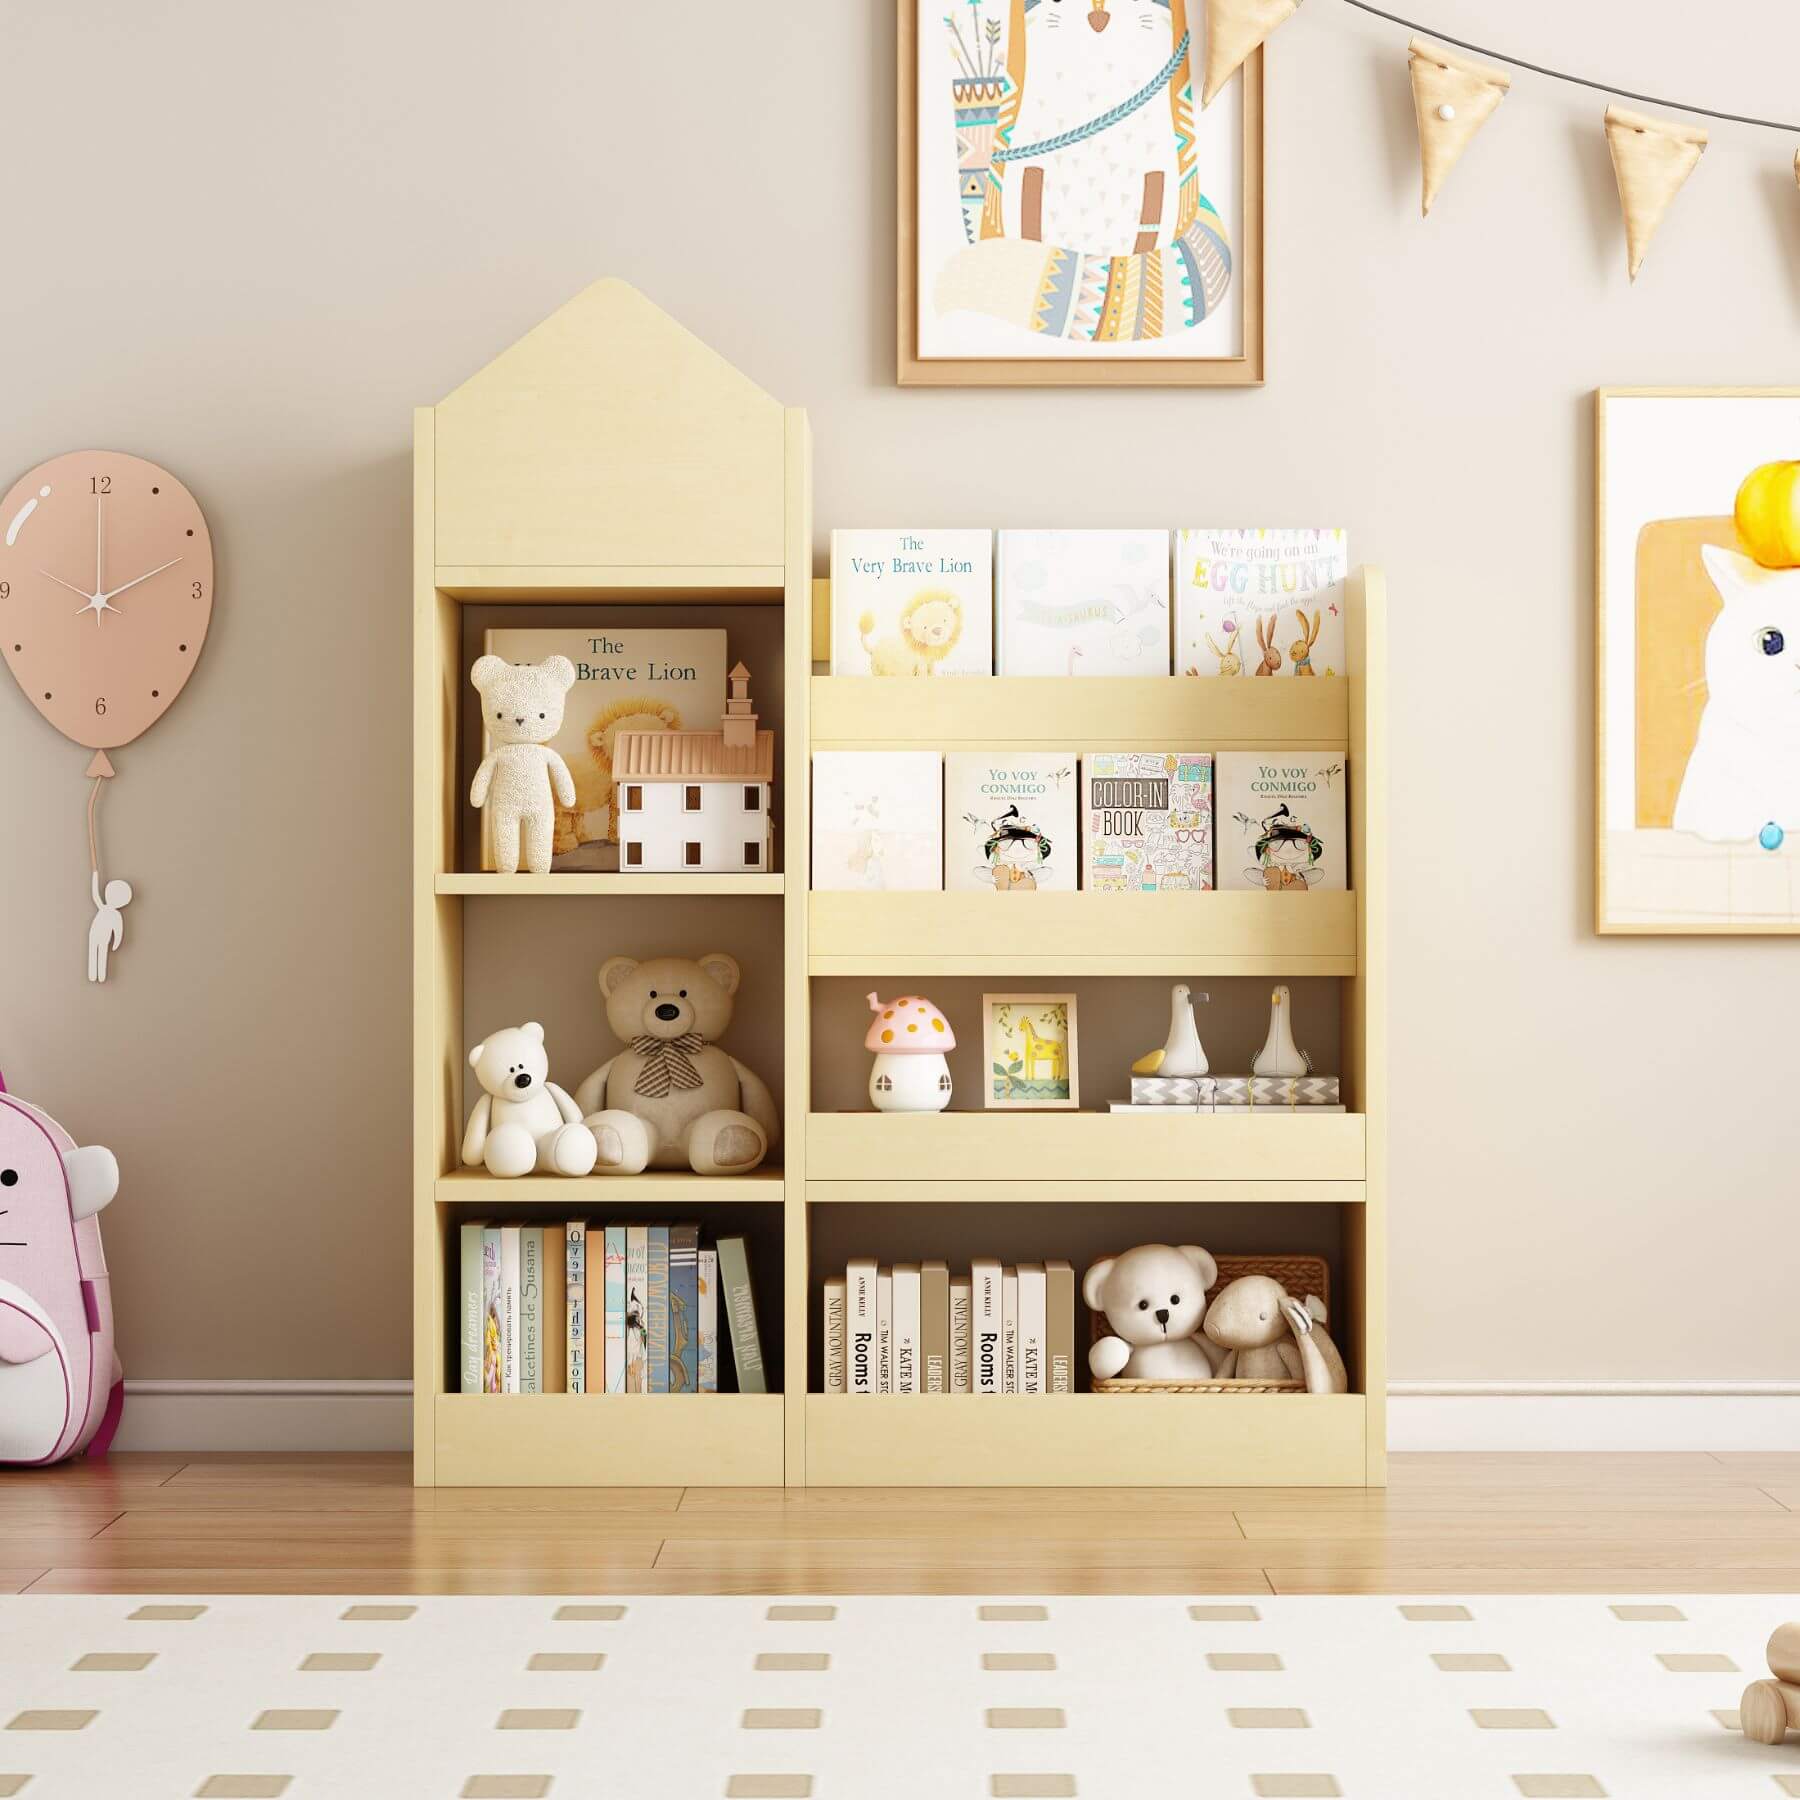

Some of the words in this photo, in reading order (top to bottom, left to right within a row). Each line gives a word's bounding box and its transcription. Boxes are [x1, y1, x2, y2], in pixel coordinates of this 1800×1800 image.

[90, 476, 112, 494] 12
[899, 536, 925, 551] The
[1246, 544, 1281, 562] going
[1284, 544, 1300, 556] on
[1303, 543, 1319, 554] an
[851, 557, 885, 580] Very
[892, 557, 933, 573] Brave
[940, 557, 973, 573] Lion
[1192, 557, 1249, 593] EGG
[1256, 556, 1338, 593] HUNT
[0, 581, 11, 600] 9
[191, 581, 203, 600] 3
[588, 637, 625, 655] The
[576, 663, 638, 682] Brave
[647, 663, 697, 682] Lion
[95, 697, 107, 716] 6
[980, 783, 1047, 794] CONMIGO
[1250, 781, 1317, 792] CONMIGO
[1103, 810, 1144, 836] BOOK
[520, 1240, 537, 1299] Susana
[520, 1303, 536, 1321] de
[858, 1296, 867, 1317] KELLY
[463, 1290, 479, 1352] dreamers
[829, 1297, 843, 1357] MOUNTAIN
[954, 1297, 968, 1357] MOUNTAIN
[880, 1330, 889, 1344] TIM
[1006, 1330, 1014, 1344] TIM
[463, 1355, 480, 1385] Day
[855, 1332, 872, 1386] Rooms
[880, 1346, 889, 1379] WALKER
[900, 1348, 912, 1379] KATE
[980, 1332, 998, 1386] Rooms
[1006, 1346, 1014, 1379] WALKER
[1025, 1348, 1038, 1379] KATE
[829, 1359, 842, 1387] GRAY
[927, 1355, 942, 1393] LEADERS
[954, 1359, 968, 1387] GRAY
[1053, 1355, 1068, 1393] LEADERS
[900, 1382, 912, 1393] M
[1025, 1382, 1038, 1393] M
